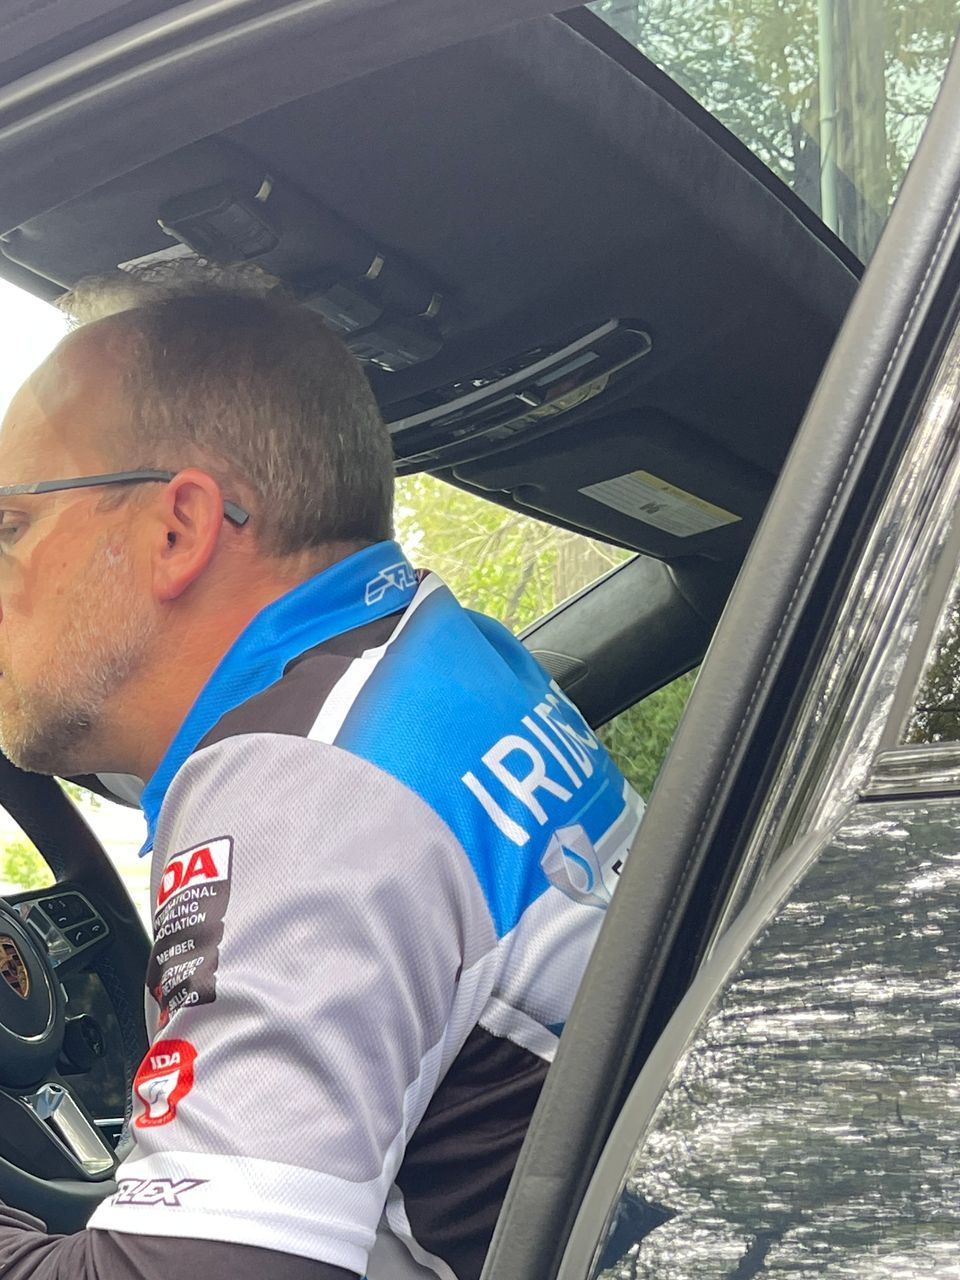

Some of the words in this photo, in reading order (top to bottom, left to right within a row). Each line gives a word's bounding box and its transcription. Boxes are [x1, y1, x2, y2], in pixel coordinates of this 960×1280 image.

[157, 846, 219, 907] DA
[156, 939, 196, 966] MEMBER
[149, 1052, 181, 1070] IDA
